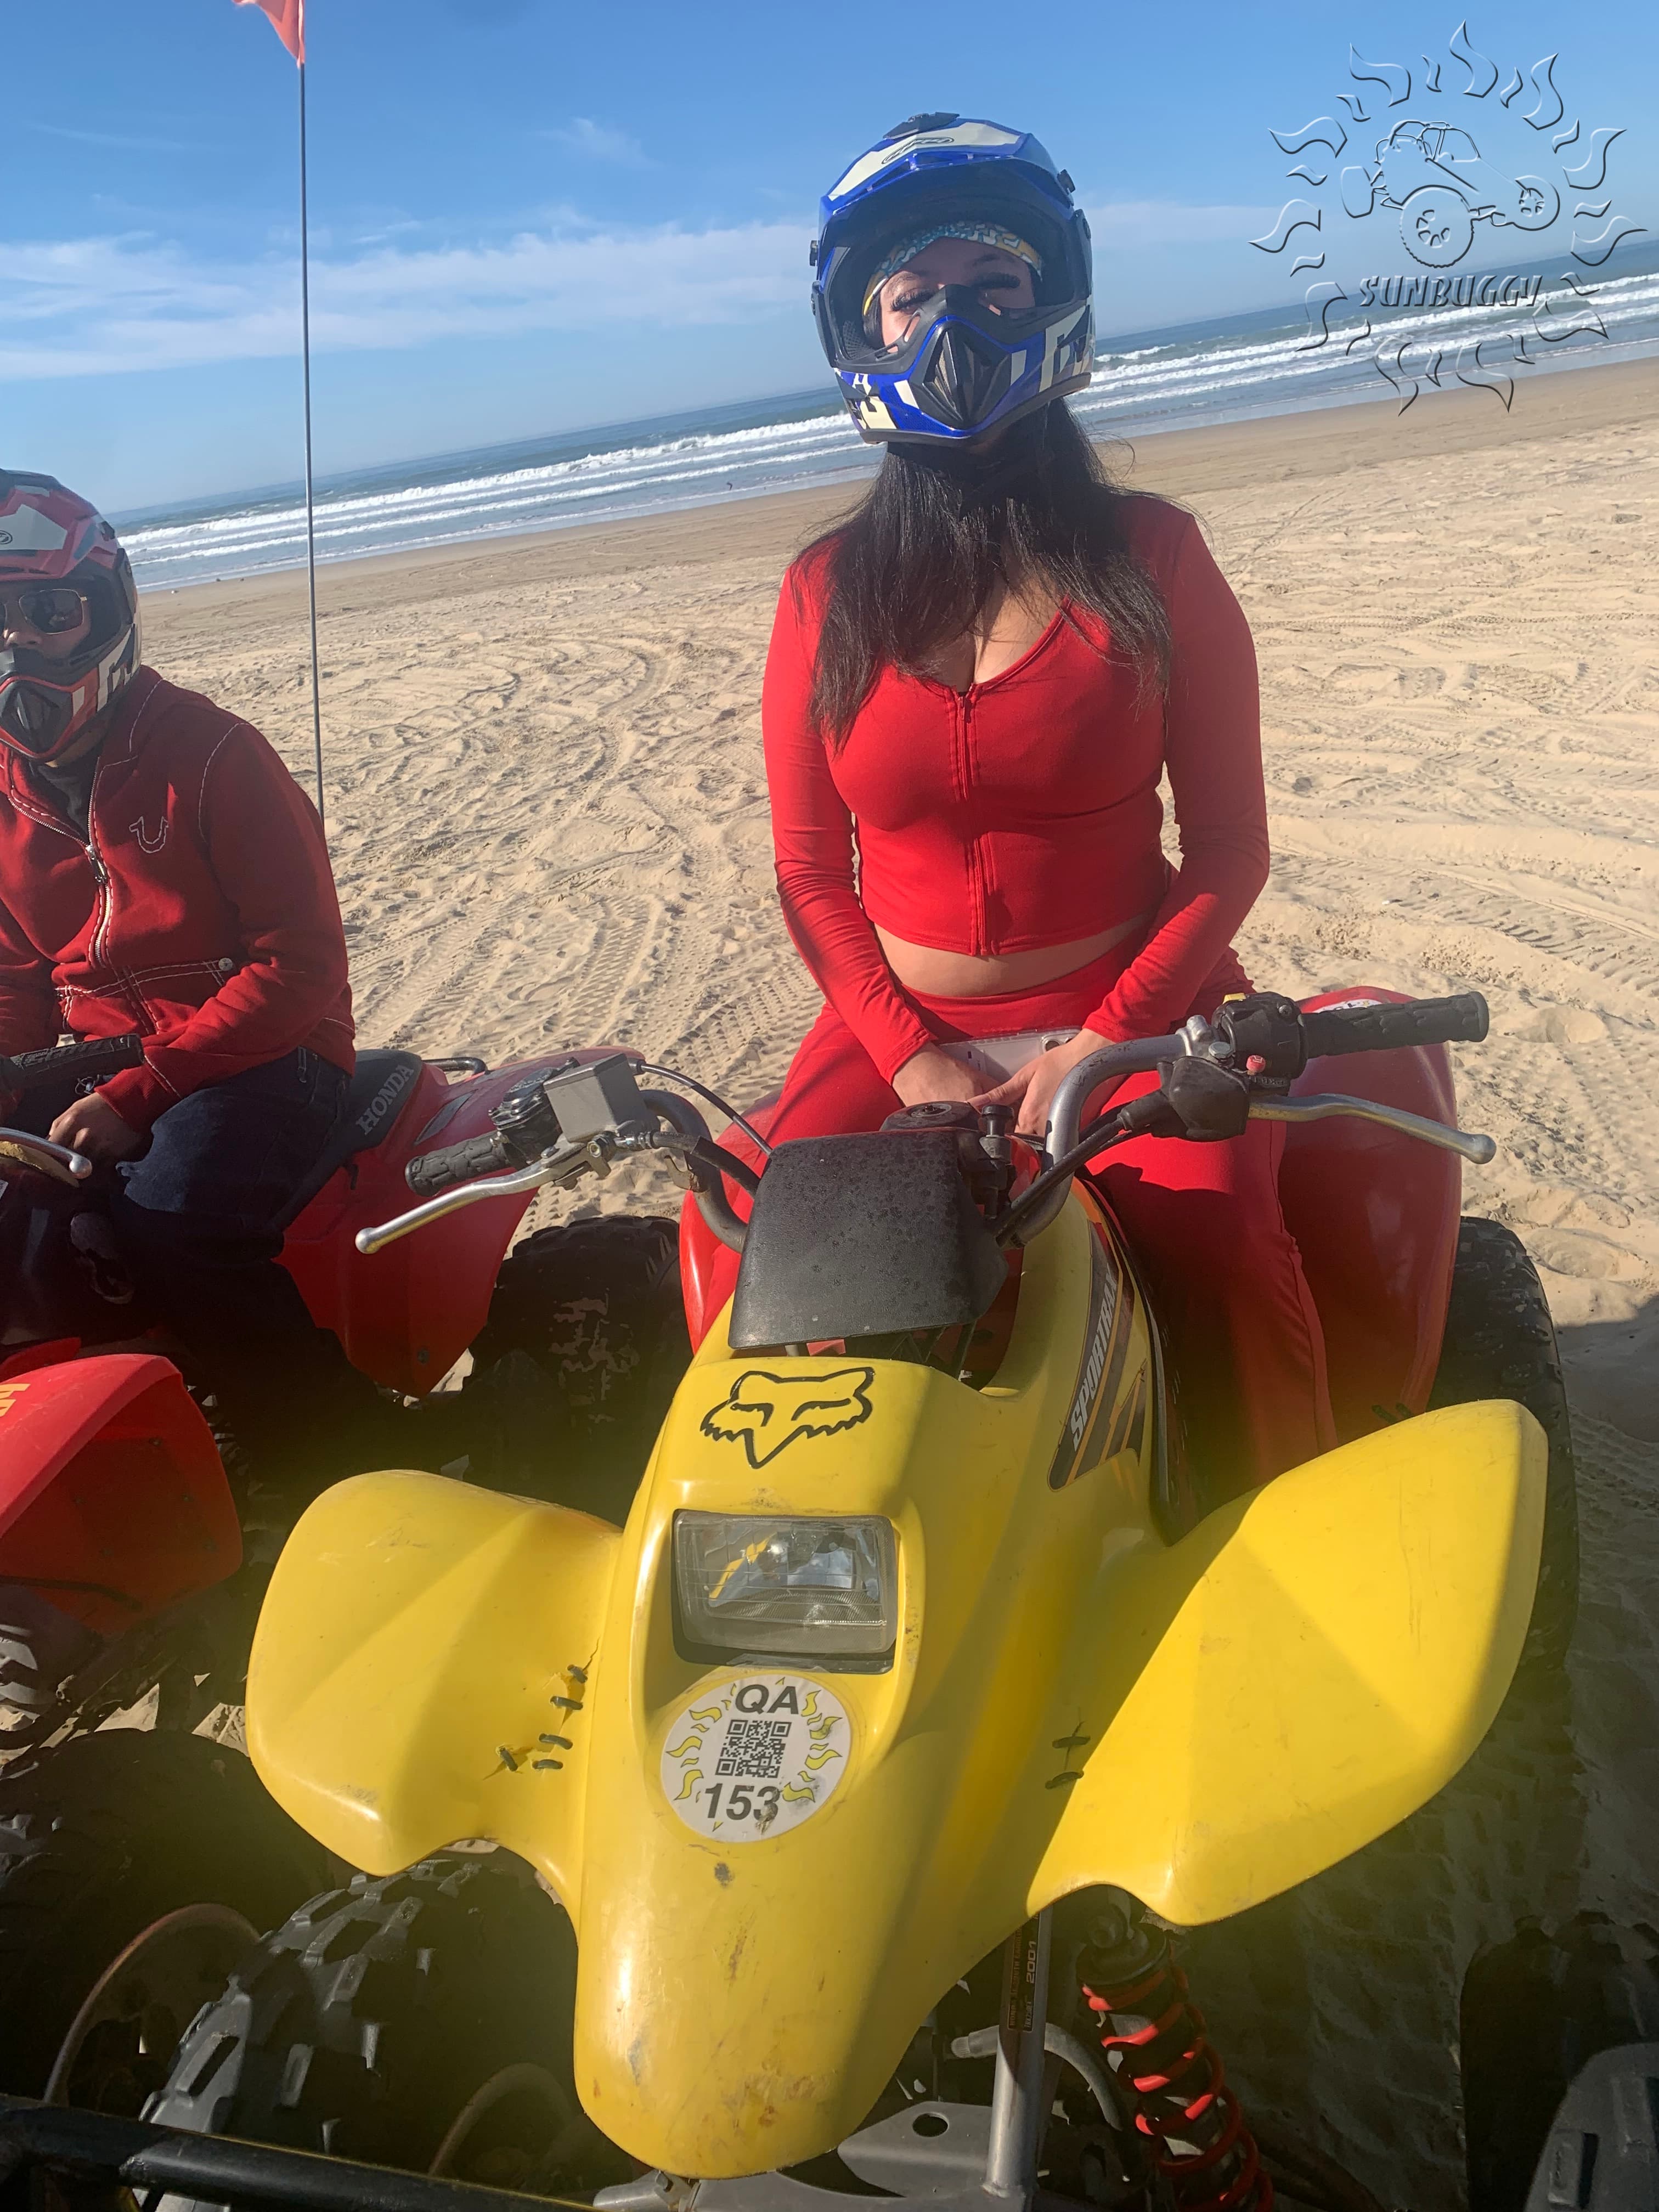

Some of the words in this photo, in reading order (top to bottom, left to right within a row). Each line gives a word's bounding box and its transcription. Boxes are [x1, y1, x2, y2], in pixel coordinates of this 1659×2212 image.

[356, 1065, 414, 1135] HONDA
[1070, 1262, 1117, 1452] SPORTRAX
[735, 1684, 799, 1715] QA
[705, 1783, 781, 1821] 153
[1026, 1941, 1036, 1983] 2001
